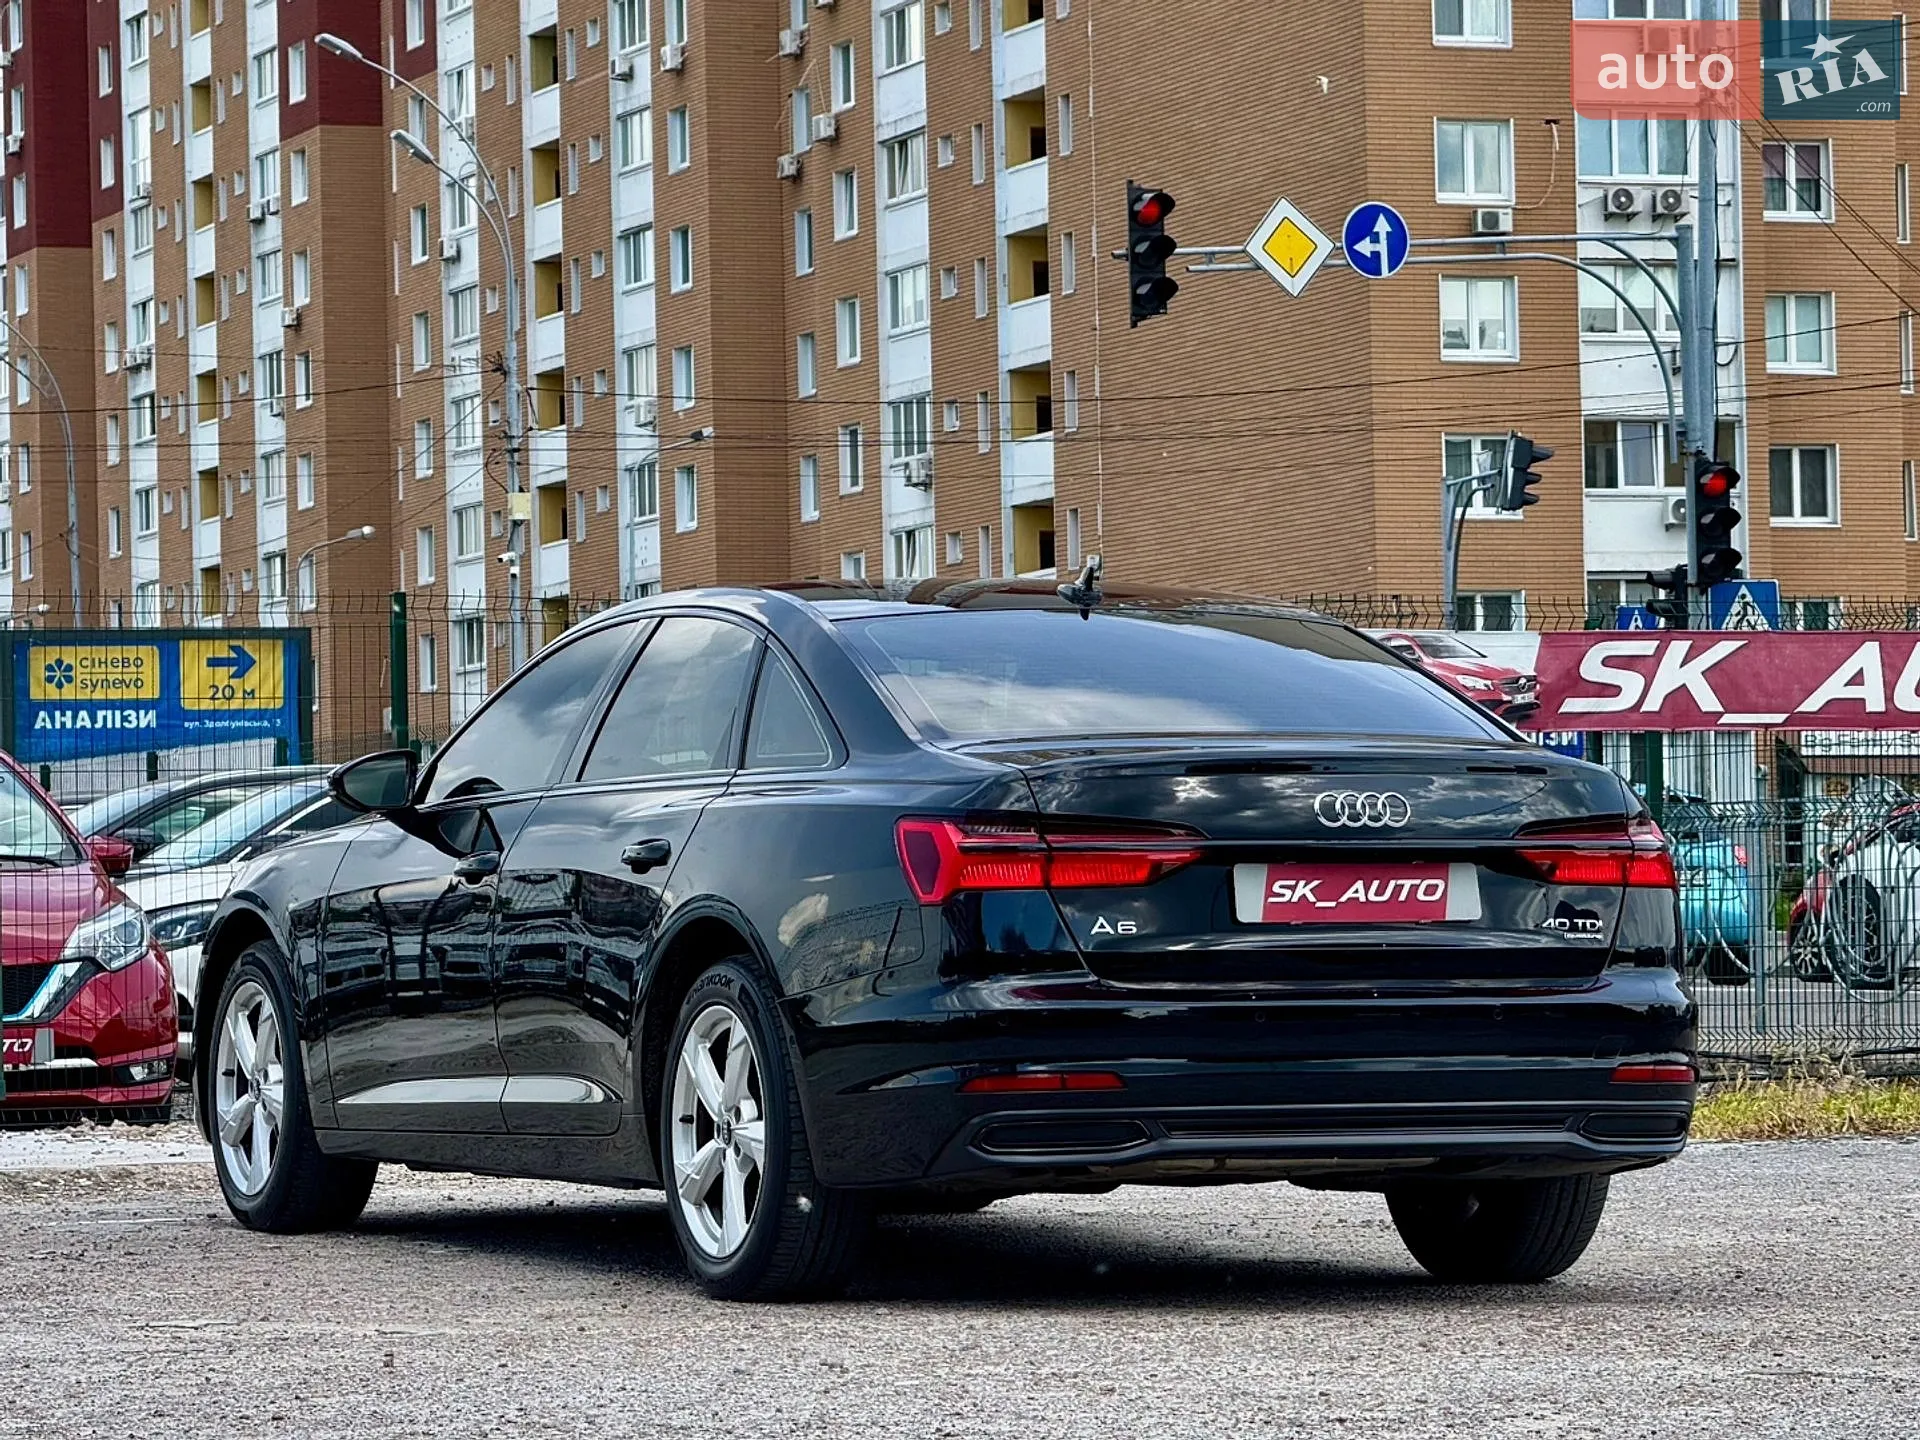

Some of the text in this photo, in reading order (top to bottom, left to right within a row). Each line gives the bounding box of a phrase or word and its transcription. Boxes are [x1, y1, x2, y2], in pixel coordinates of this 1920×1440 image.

[80, 677, 144, 693] synevo
[1558, 639, 1920, 725] SK_A
[208, 684, 235, 701] 20
[34, 709, 156, 729] АНАЛІЗИ
[1267, 878, 1446, 908] SK_AUTO
[1090, 916, 1137, 935] A6
[1541, 918, 1603, 931] 40 TDI
